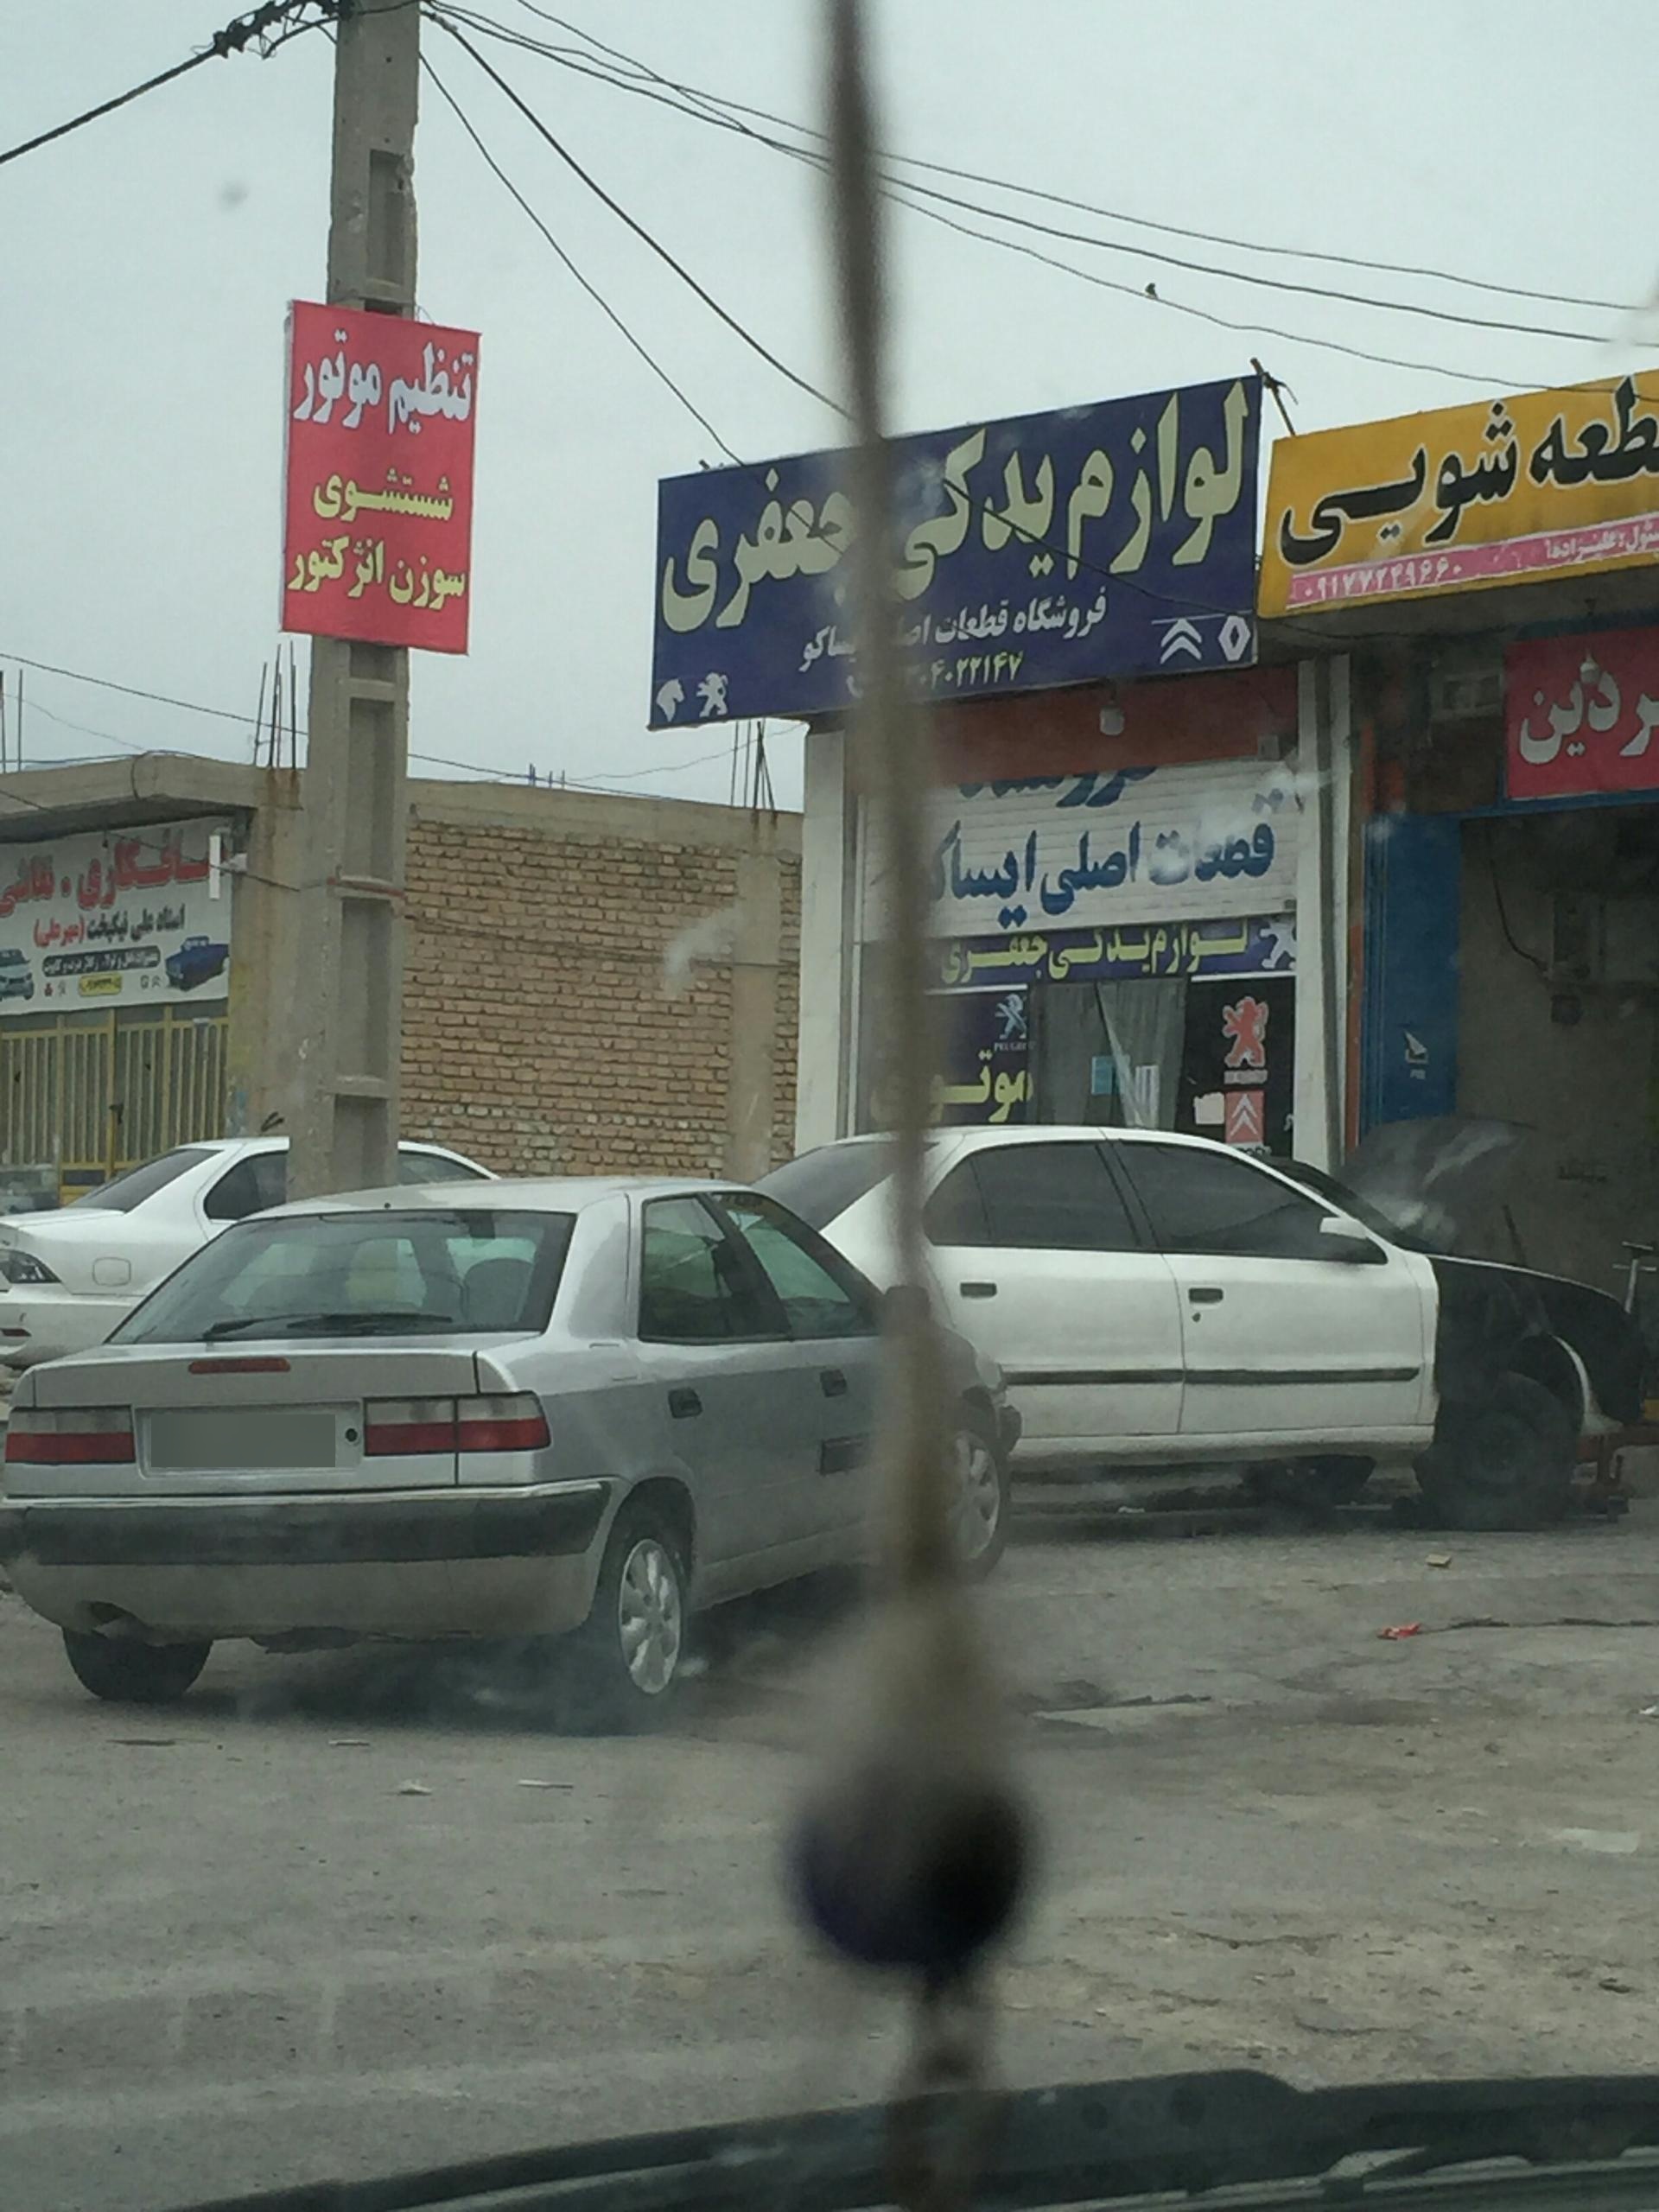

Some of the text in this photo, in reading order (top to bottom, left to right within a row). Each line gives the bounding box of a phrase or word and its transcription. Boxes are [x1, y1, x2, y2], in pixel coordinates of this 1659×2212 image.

[294, 329, 475, 435] تنظیم موتور
[314, 467, 454, 522] شستشوی
[662, 378, 1249, 633] لوازم یدکی جعفری
[1280, 375, 1659, 567] طعه شویی
[389, 556, 467, 610] سوزن
[934, 599, 1010, 644] قطعات
[1014, 586, 1108, 640] فروشگاه
[1518, 670, 1659, 766] ردین
[1039, 820, 1141, 916] اصلی
